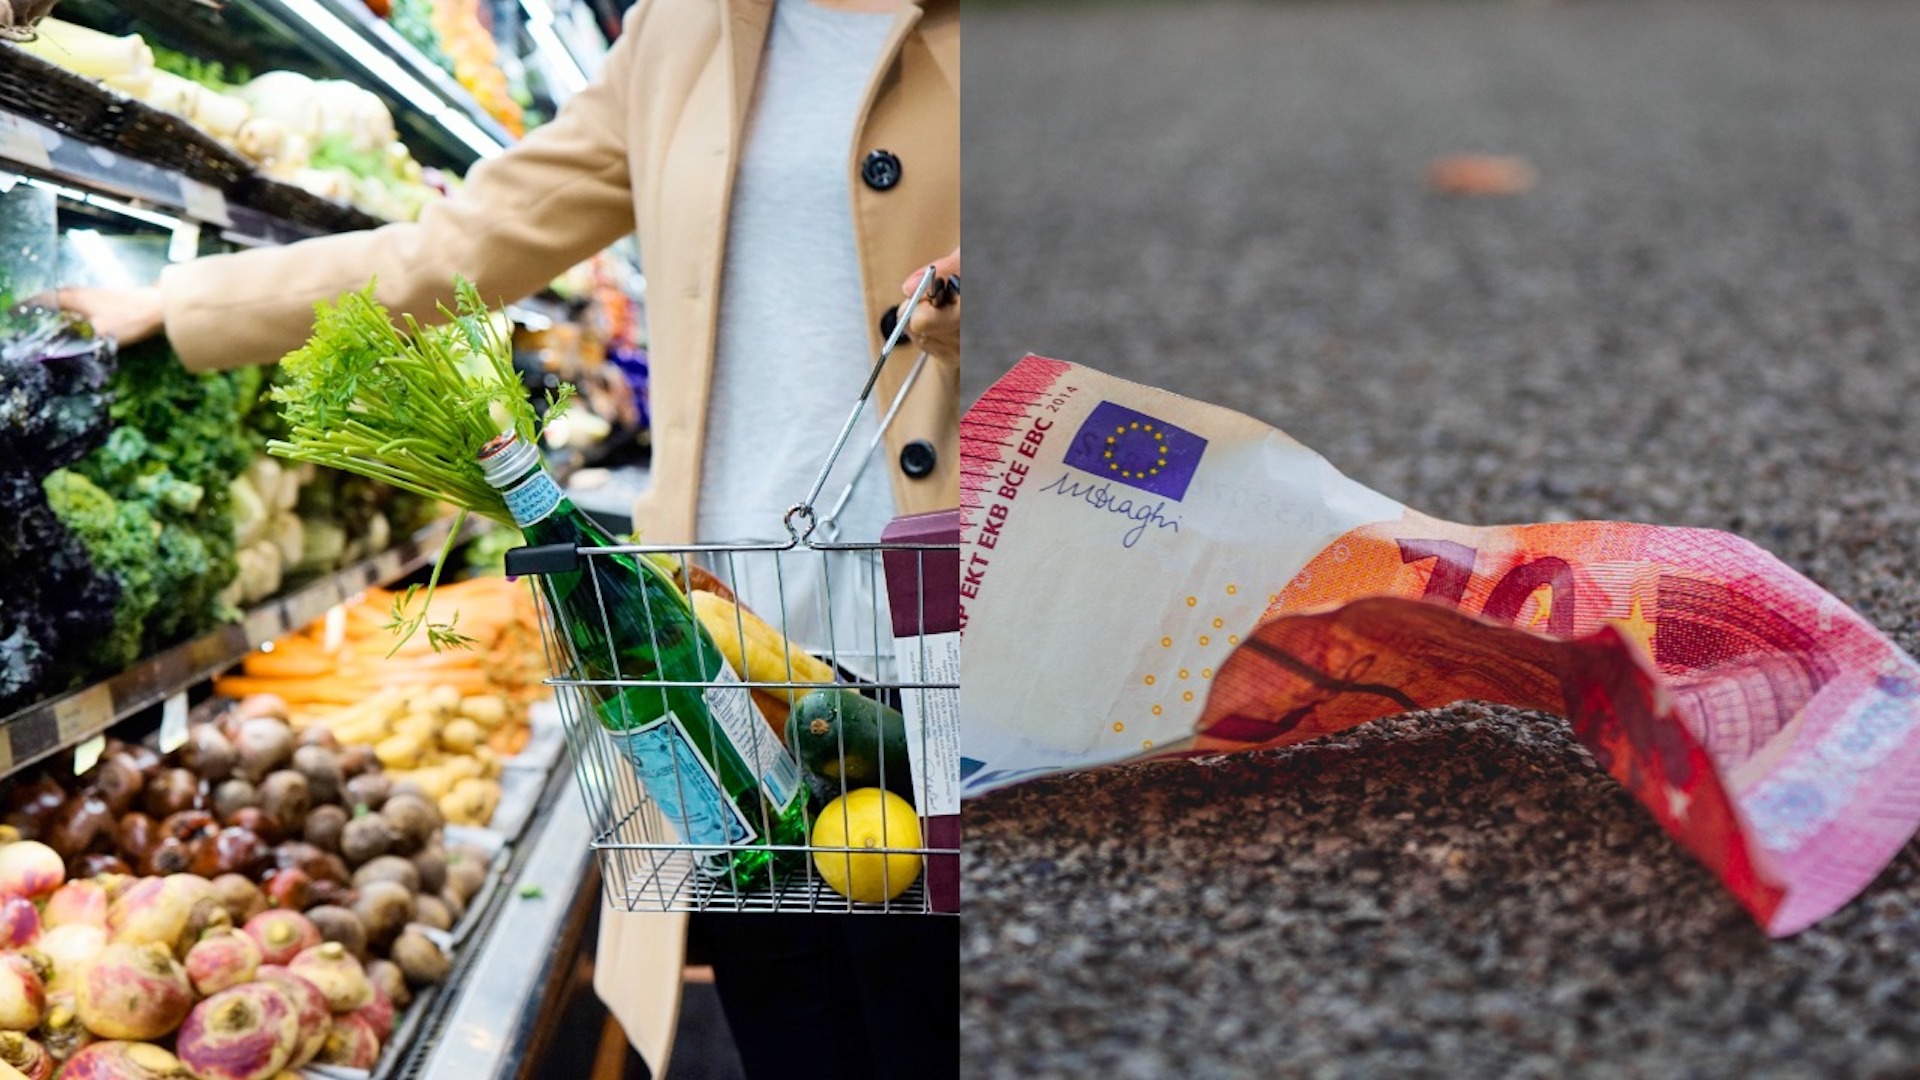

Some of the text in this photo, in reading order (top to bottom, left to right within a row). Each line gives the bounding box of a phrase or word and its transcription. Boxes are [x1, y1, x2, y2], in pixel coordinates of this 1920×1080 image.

[976, 503, 1009, 550] EKB
[1018, 417, 1054, 459] EBC
[1045, 386, 1078, 413] 2014
[1396, 538, 1575, 641] 10
